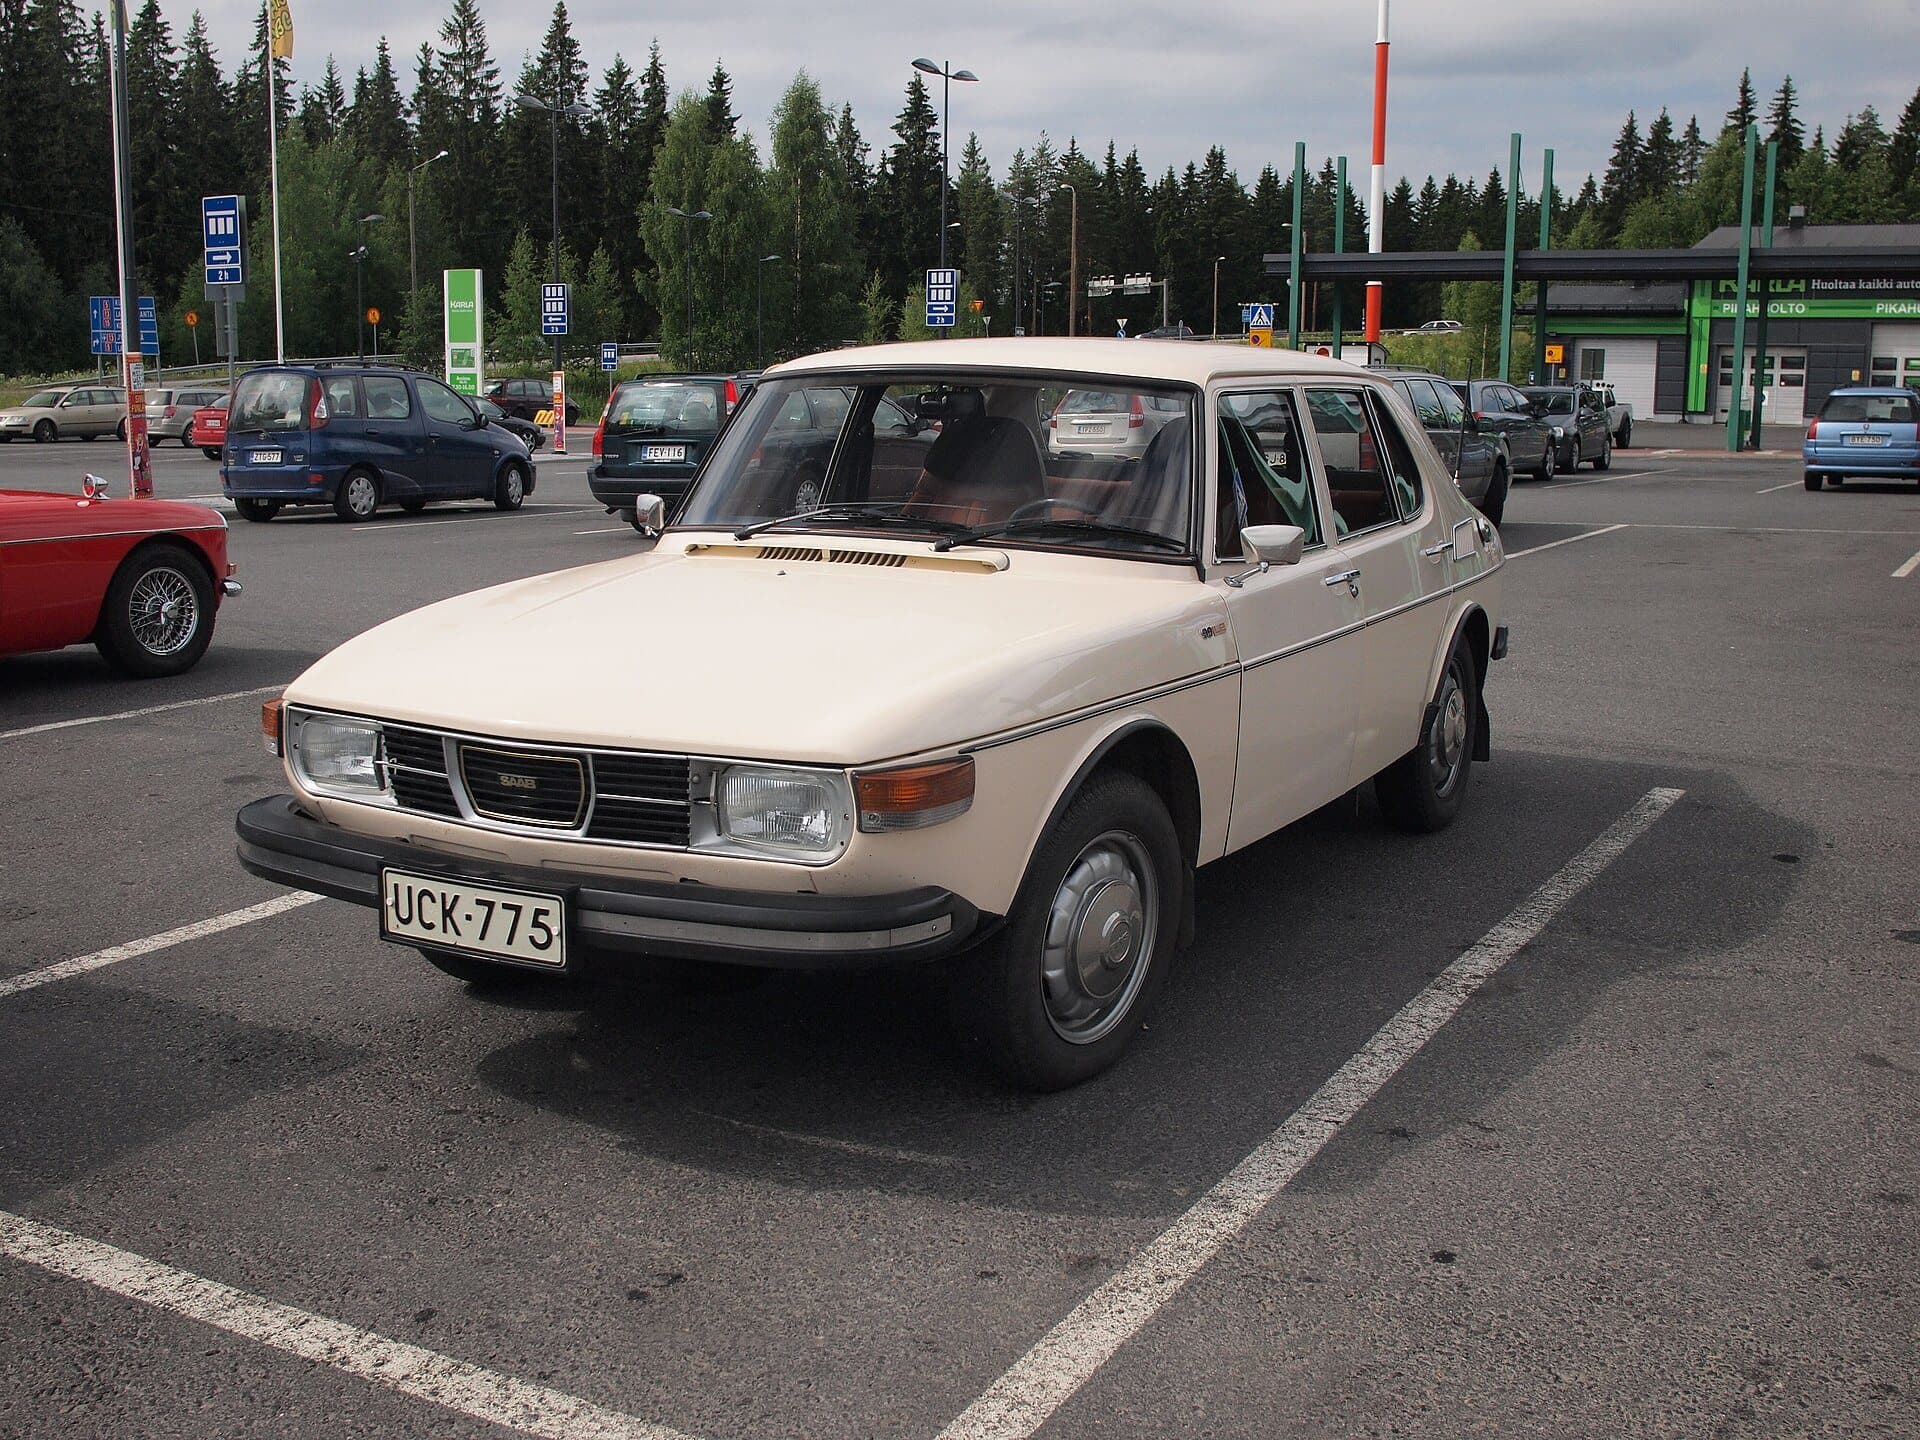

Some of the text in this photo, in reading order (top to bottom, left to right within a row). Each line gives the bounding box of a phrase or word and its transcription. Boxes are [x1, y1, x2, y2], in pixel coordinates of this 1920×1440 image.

[1811, 279, 1856, 289] Huoltaa
[1858, 279, 1893, 289] kaikki
[1722, 303, 1805, 313] PIAHOLTO
[500, 775, 537, 789] SAAB
[394, 883, 553, 950] UCK-775
